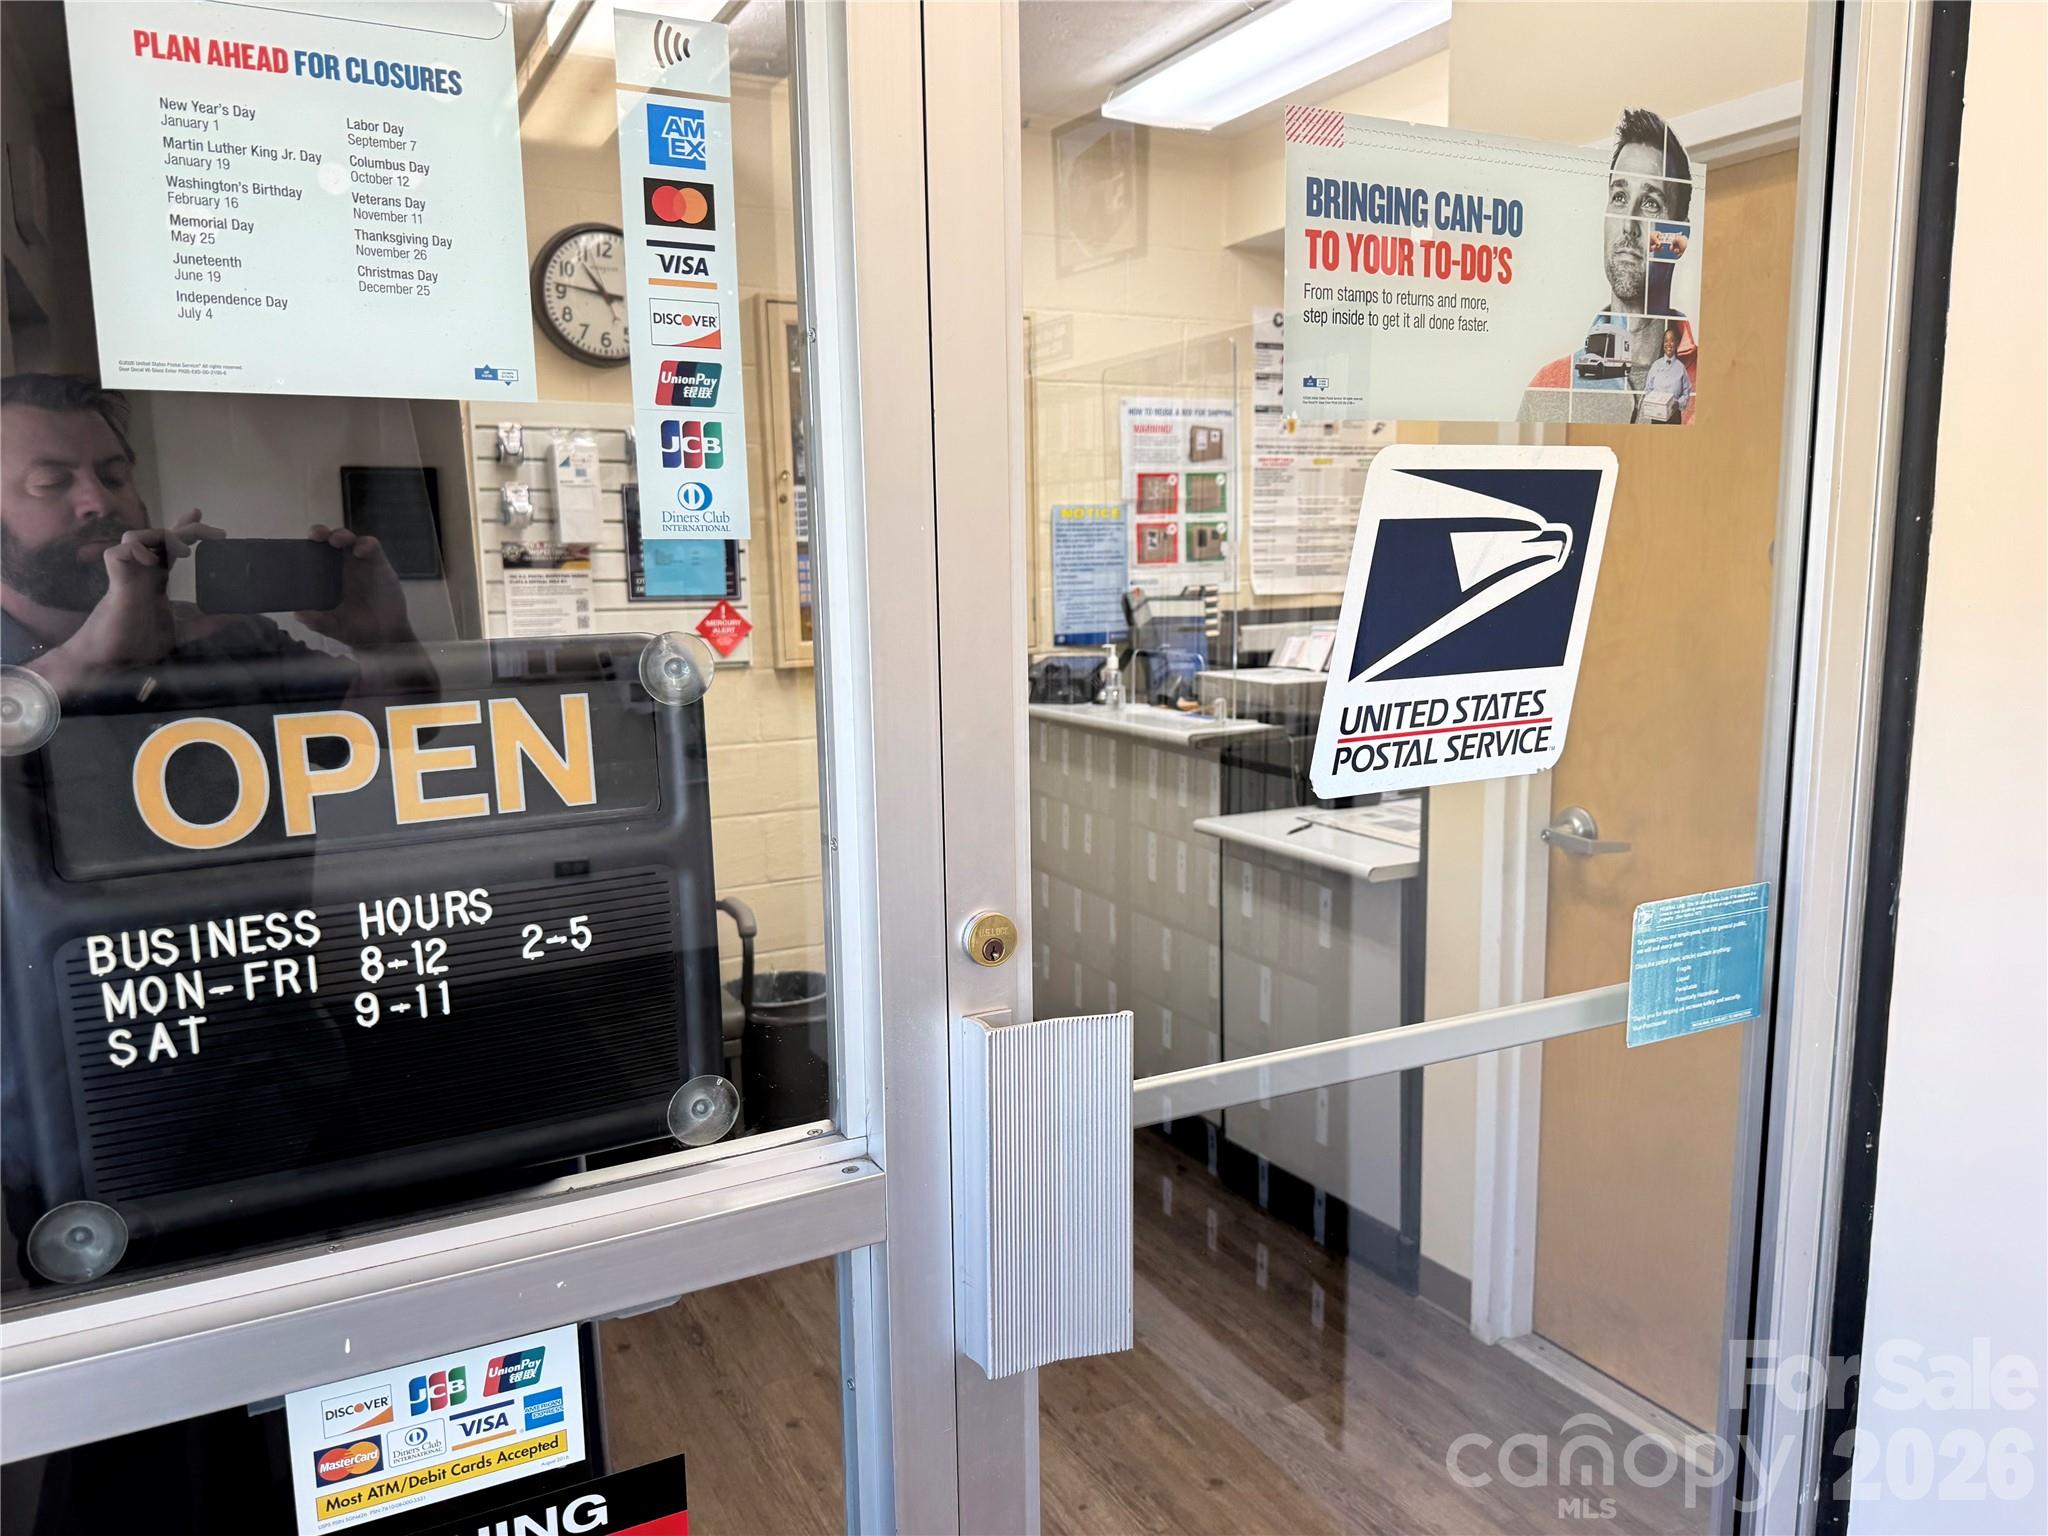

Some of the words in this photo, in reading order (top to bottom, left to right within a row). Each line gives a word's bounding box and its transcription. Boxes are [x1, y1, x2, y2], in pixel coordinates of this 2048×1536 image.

[133, 30, 200, 63] PLAN
[207, 38, 288, 74] AHEAD
[295, 50, 340, 81] FOR
[346, 57, 462, 96] CLOSURES
[160, 97, 188, 113] New
[192, 100, 228, 117] Year's
[232, 104, 256, 121] Day
[161, 114, 209, 132] January
[213, 119, 219, 131] 1
[346, 118, 379, 134] Labor
[382, 122, 405, 138] Day
[662, 117, 705, 139] AM
[163, 136, 203, 152] Martin
[208, 140, 245, 157] Luther
[249, 144, 278, 162] King
[281, 147, 296, 161] Jr.
[300, 150, 322, 166] Day
[348, 133, 407, 153] September
[410, 139, 417, 152] 7
[670, 138, 706, 160] EX
[164, 153, 211, 170] January
[216, 158, 231, 170] 19
[349, 154, 404, 172] Columbus
[407, 160, 430, 176] Day
[166, 174, 249, 196] Washington's
[252, 182, 303, 200] Birthday
[350, 170, 394, 187] October
[397, 174, 410, 187] 12
[167, 191, 221, 209] February
[224, 196, 239, 209] 16
[352, 192, 402, 208] Veterans
[404, 196, 426, 212] Day
[1306, 176, 1428, 228] BRINGING
[1435, 190, 1524, 238] CAN-DO
[169, 214, 229, 231] Memorial
[232, 218, 255, 235] Day
[353, 207, 408, 224] November
[411, 212, 423, 225] 11
[170, 230, 196, 246] May
[200, 232, 216, 245] 25
[354, 229, 429, 249] Thanksgiving
[432, 234, 453, 250] Day
[356, 244, 411, 260] November
[414, 248, 428, 261] 26
[596, 242, 613, 259] 12
[1305, 228, 1340, 272] TO
[1346, 232, 1414, 277] YOUR
[1420, 240, 1513, 285] TO-DO'S
[172, 252, 242, 269] Juneteenth
[560, 260, 575, 278] 10
[656, 254, 709, 276] VISA
[174, 268, 204, 282] June
[208, 270, 222, 283] 19
[357, 265, 414, 282] Christmas
[416, 268, 439, 284] Day
[358, 280, 414, 296] December
[417, 283, 431, 297] 25
[555, 282, 567, 300] 9
[1304, 283, 1334, 301] From
[1338, 286, 1379, 308] stamps
[1382, 289, 1393, 304] to
[1396, 290, 1435, 307] returns
[1438, 292, 1458, 308] and
[1460, 297, 1489, 313] more,
[176, 290, 263, 308] Independence
[265, 295, 289, 312] Day
[178, 306, 202, 323] July
[205, 308, 214, 320] 4
[562, 306, 573, 323] 8
[653, 312, 717, 329] DISCOVER
[1303, 309, 1328, 328] step
[1332, 309, 1365, 327] inside
[1368, 312, 1379, 327] to
[1382, 314, 1401, 332] get
[1403, 313, 1411, 329] it
[1414, 314, 1426, 330] all
[1429, 316, 1455, 332] done
[1458, 316, 1489, 333] faster.
[578, 324, 590, 341] 7
[601, 332, 612, 348] 6
[661, 371, 718, 389] UnionPay
[683, 386, 713, 399] 银联
[1128, 408, 1143, 416] HOW
[662, 436, 721, 454] JCB
[662, 511, 700, 524] Diners
[702, 510, 731, 524] Club
[1060, 508, 1121, 520] NOTICE
[662, 524, 732, 533] INTERNATIONAL
[705, 618, 741, 627] MERCURY
[712, 626, 735, 634] ALERT
[1339, 698, 1449, 736] UNITED
[1453, 690, 1546, 724] STATES
[1332, 738, 1438, 776] POSTAL
[1444, 726, 1552, 763] SERVICE
[132, 692, 597, 850] OPEN
[86, 909, 321, 976] BUSINESS
[358, 887, 493, 940] HOURS
[102, 955, 318, 1022] MON-FRI
[361, 938, 449, 983] 8-12
[521, 916, 593, 961] 2-5
[108, 1016, 206, 1068] SAT
[354, 980, 451, 1028] 9-11
[488, 1358, 542, 1379] UnionPay
[509, 1368, 537, 1384] 银联
[413, 1378, 466, 1404] JCB
[324, 1395, 389, 1422] DISCOVER
[525, 1398, 562, 1413] AMERICAN
[532, 1407, 565, 1419] EXPRESS
[458, 1412, 510, 1438] VISA
[392, 1444, 421, 1460] Diners
[422, 1439, 443, 1454] Club
[393, 1448, 443, 1464] INTERNATIONAL
[320, 1448, 379, 1476] MasterCard
[326, 1492, 365, 1513] Most
[367, 1466, 447, 1501] ATM/Debit
[450, 1457, 493, 1478] Cards
[496, 1435, 559, 1466] Accepted
